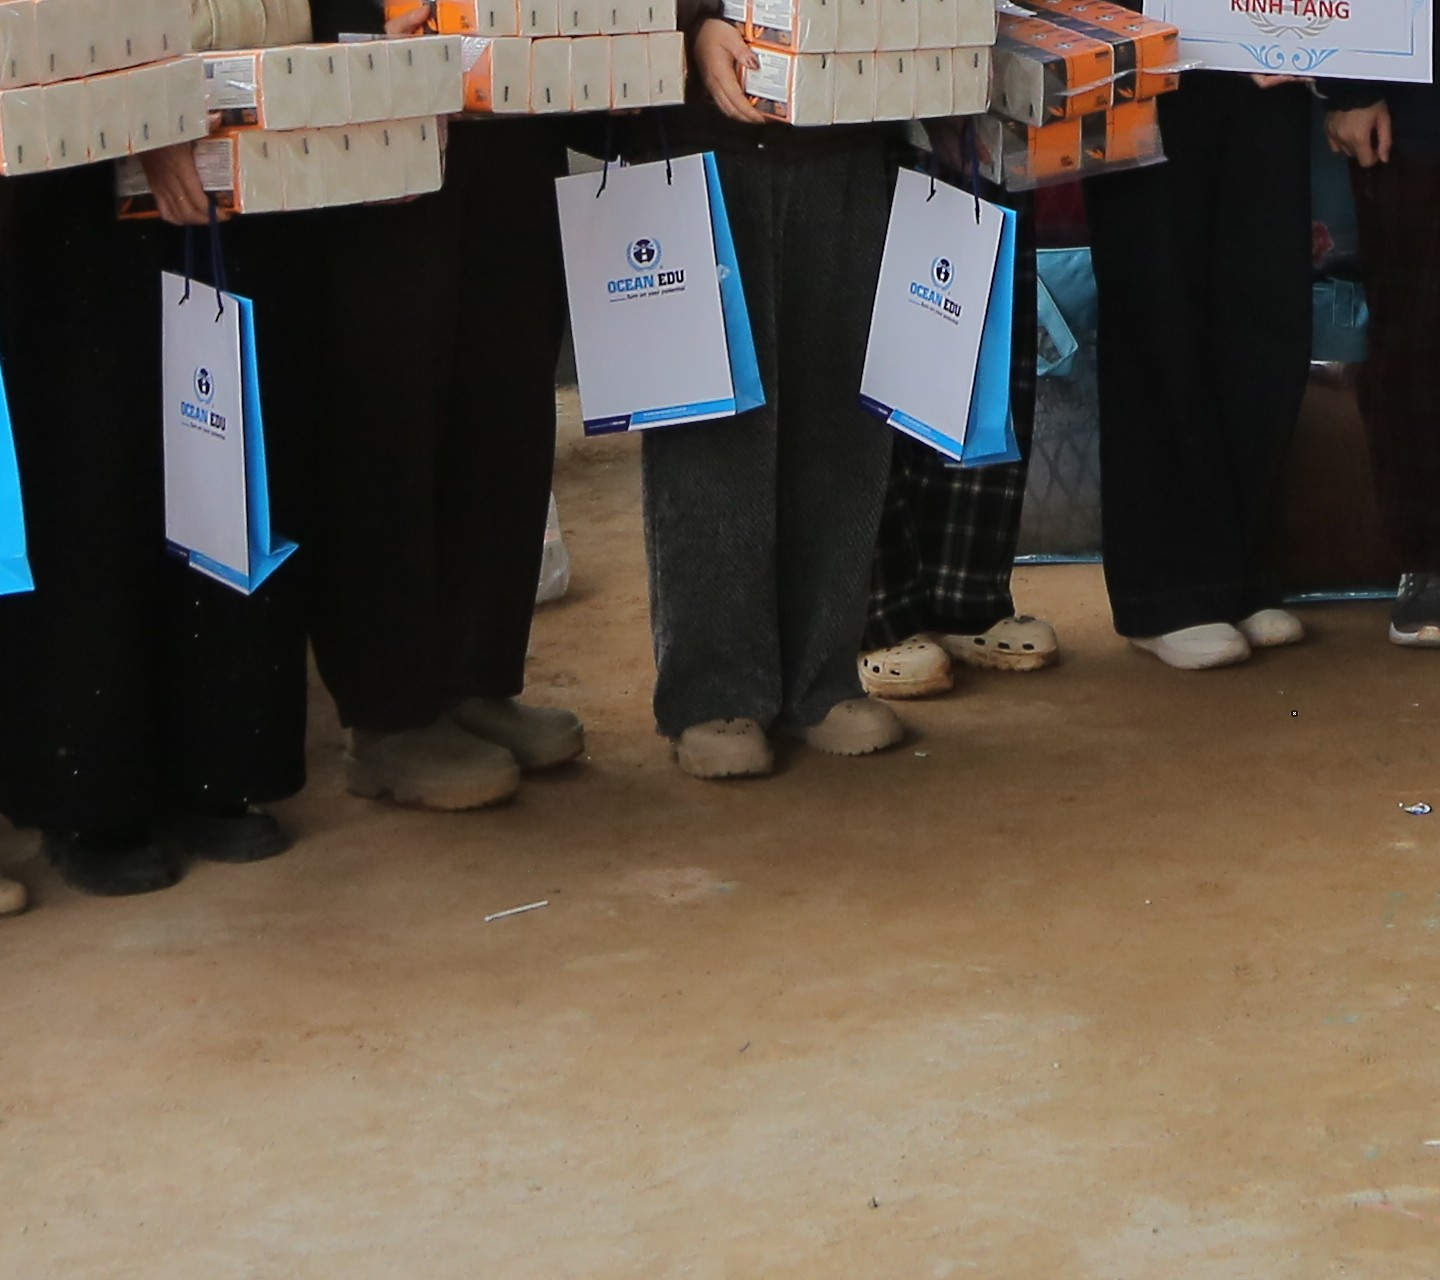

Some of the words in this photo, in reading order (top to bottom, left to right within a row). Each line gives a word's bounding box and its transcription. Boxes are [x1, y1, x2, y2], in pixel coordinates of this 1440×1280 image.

[607, 274, 654, 293] OCEAN
[658, 269, 684, 286] EDU
[910, 282, 943, 307] OCEAN
[944, 298, 961, 317] EDU
[181, 401, 209, 423] OCEAN
[210, 412, 226, 431] EDU
